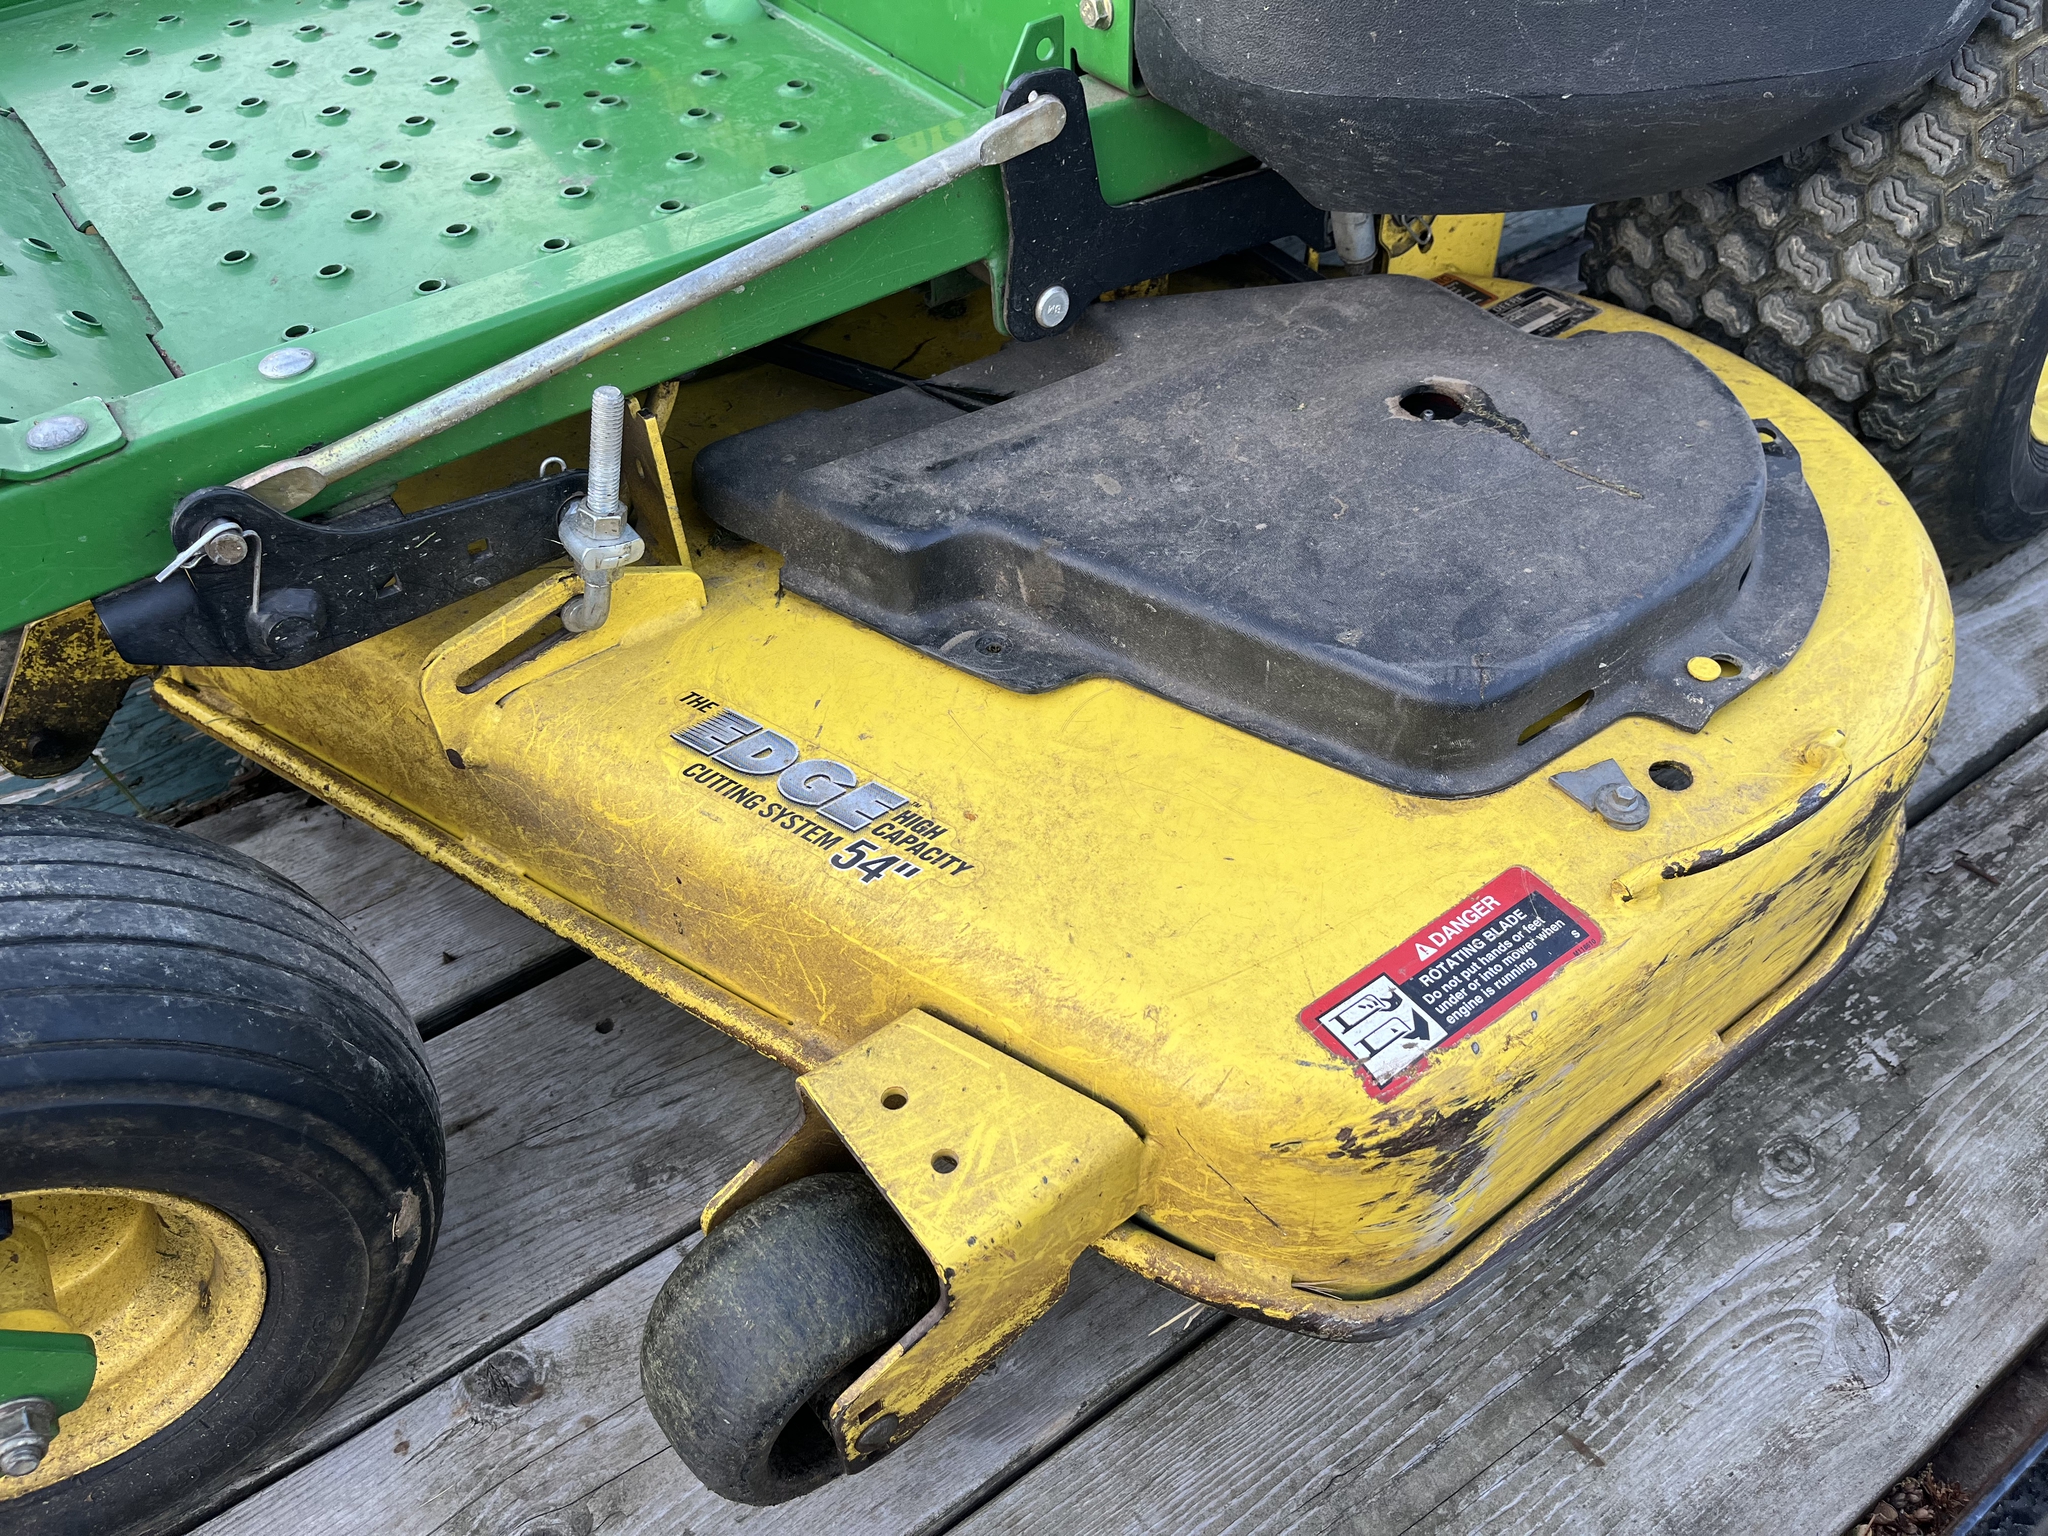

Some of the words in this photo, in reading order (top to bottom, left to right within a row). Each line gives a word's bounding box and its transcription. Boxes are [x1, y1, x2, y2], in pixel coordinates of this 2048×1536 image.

[680, 691, 720, 713] THE
[670, 707, 910, 833] EDGE
[682, 763, 767, 810] CUTTING
[758, 803, 844, 851] SYSTEM
[891, 810, 948, 841] HIGH
[871, 822, 975, 876] CAPACITY
[1419, 938, 1486, 987] ROTATING
[1482, 908, 1527, 942] BLADE
[1428, 895, 1501, 947] DANGER
[1422, 990, 1442, 1005] Do
[1441, 975, 1463, 992] not
[1460, 961, 1482, 981] put
[1477, 939, 1513, 966] hands
[1511, 930, 1525, 943] or
[1522, 915, 1546, 934] feet
[1435, 987, 1468, 1014] under
[1467, 978, 1482, 991] or
[1478, 962, 1503, 982] into
[1501, 938, 1538, 967] mower
[1535, 919, 1566, 941] when
[1446, 995, 1484, 1024] engine
[1480, 986, 1495, 998] is
[1493, 956, 1538, 990] running
